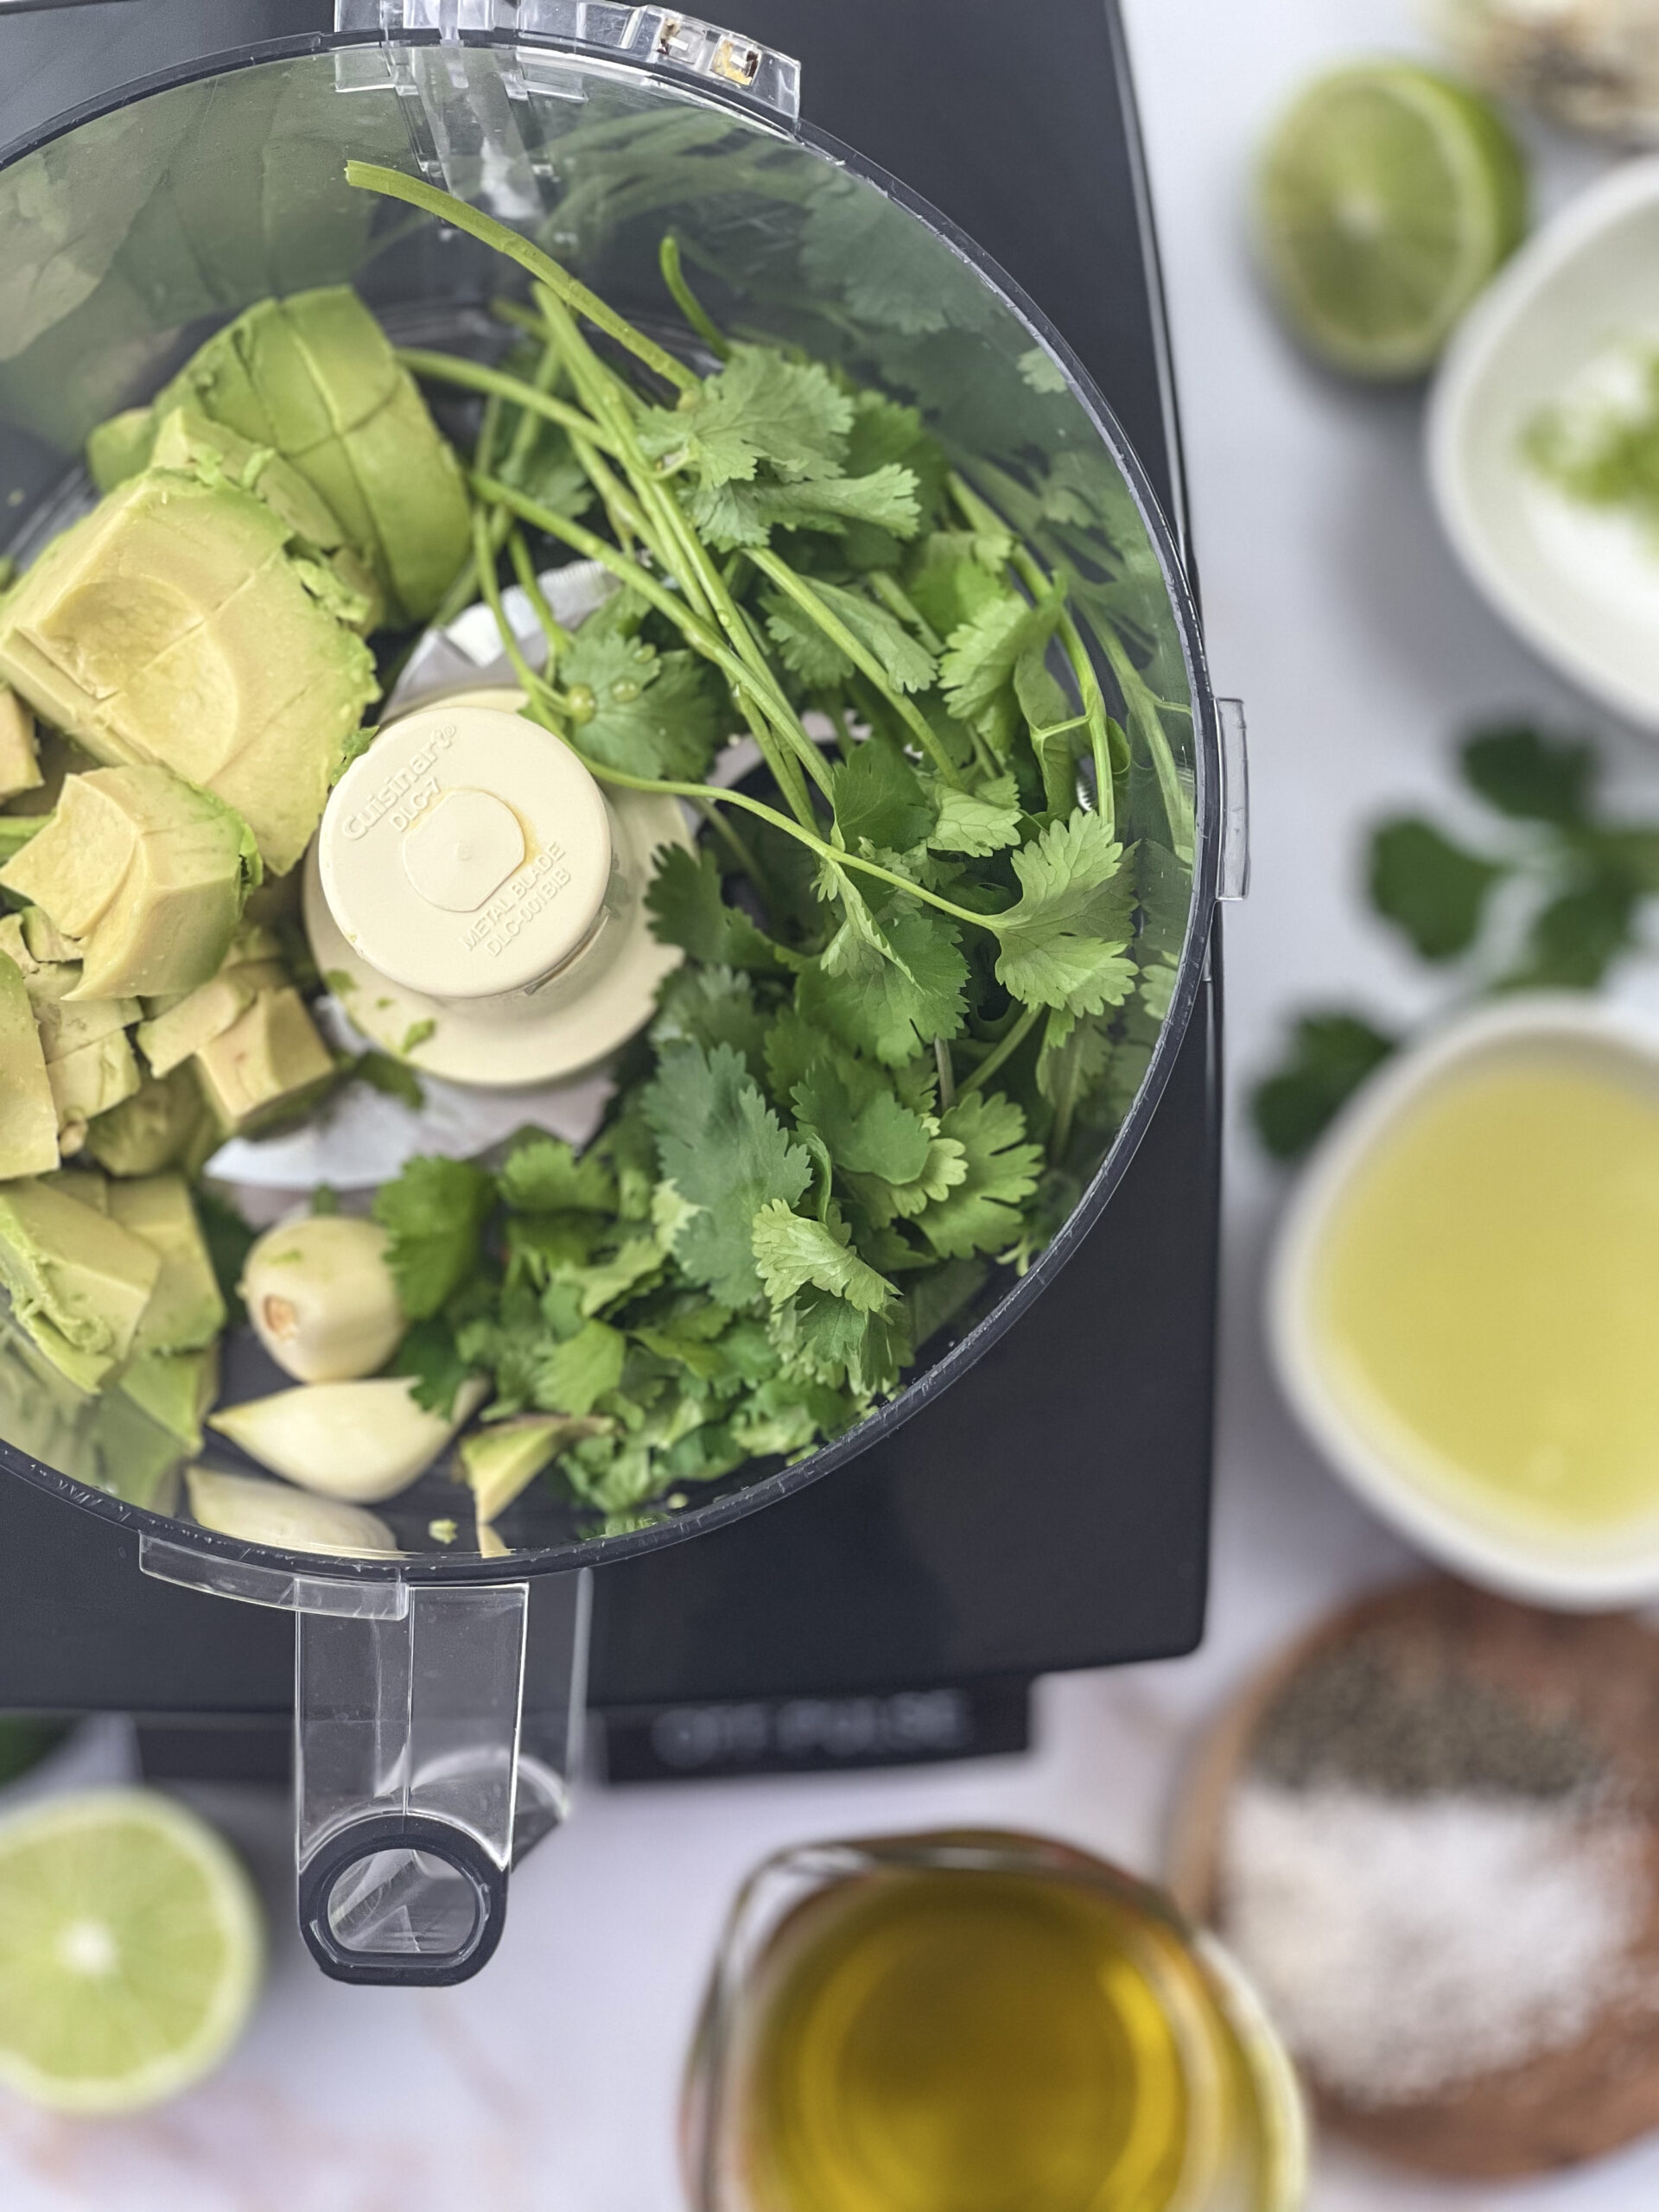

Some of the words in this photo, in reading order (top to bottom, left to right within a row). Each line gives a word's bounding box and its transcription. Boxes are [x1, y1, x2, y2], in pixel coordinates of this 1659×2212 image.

[389, 777, 442, 832] DLC-7
[457, 898, 516, 951] METAL
[508, 842, 567, 900] BLADE
